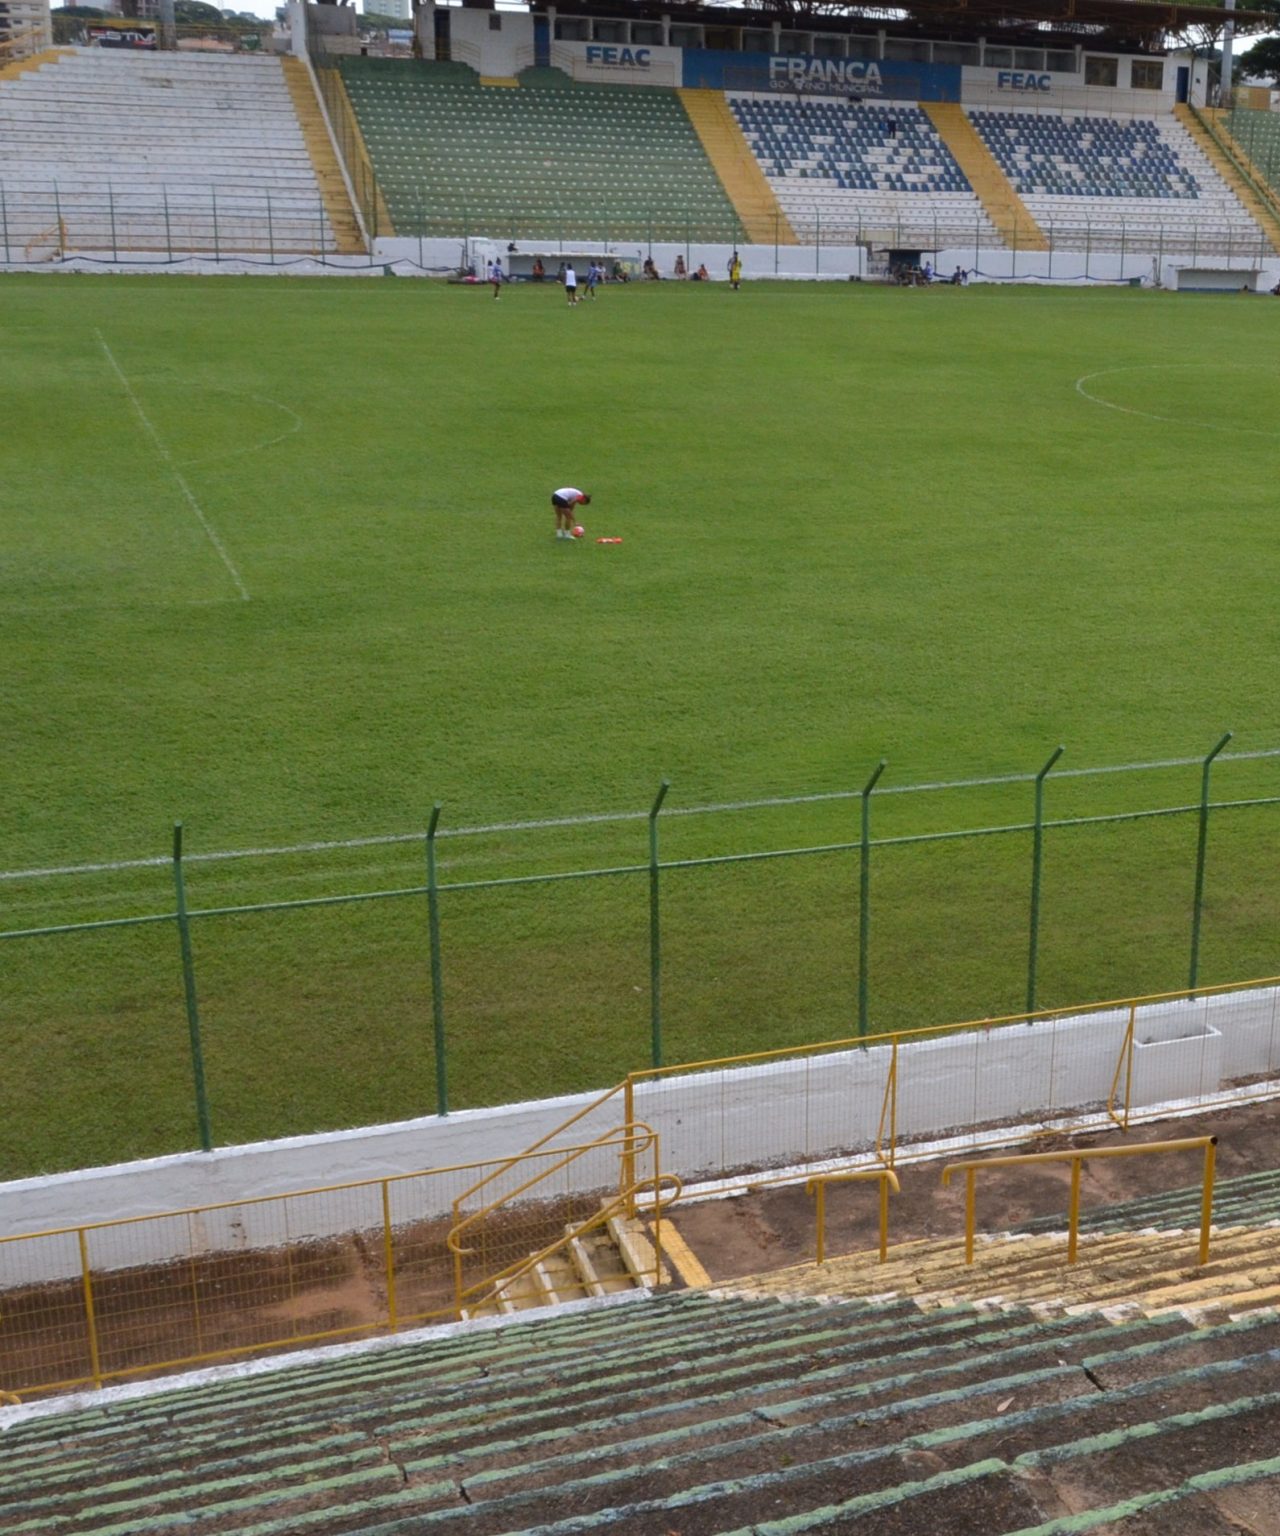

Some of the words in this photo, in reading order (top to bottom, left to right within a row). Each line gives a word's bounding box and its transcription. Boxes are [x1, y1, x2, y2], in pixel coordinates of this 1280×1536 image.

[586, 46, 650, 67] FEAC
[769, 56, 882, 85] FRANCA
[997, 72, 1051, 91] FEAC
